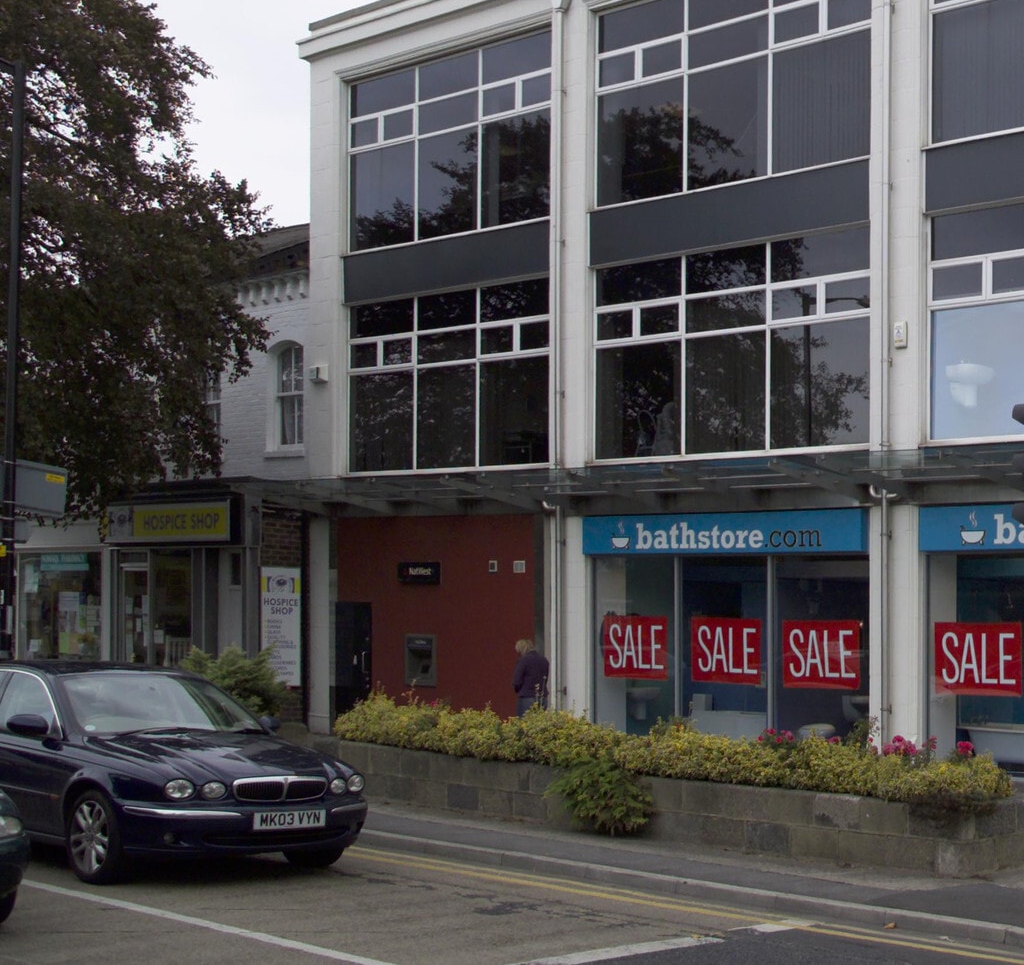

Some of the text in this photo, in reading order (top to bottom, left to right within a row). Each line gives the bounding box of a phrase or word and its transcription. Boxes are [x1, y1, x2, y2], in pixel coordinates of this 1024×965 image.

[143, 513, 219, 531] HOSPICE SHOP
[635, 522, 821, 550] bathstore.com
[408, 567, 432, 576] NatWest
[263, 598, 298, 607] HOSPICE
[270, 607, 293, 615] SHOP
[609, 624, 664, 670] SALE
[697, 626, 758, 674] SALE
[789, 628, 857, 679] SALE
[941, 631, 1016, 685] SALE
[260, 811, 321, 826] MK03 VYN
